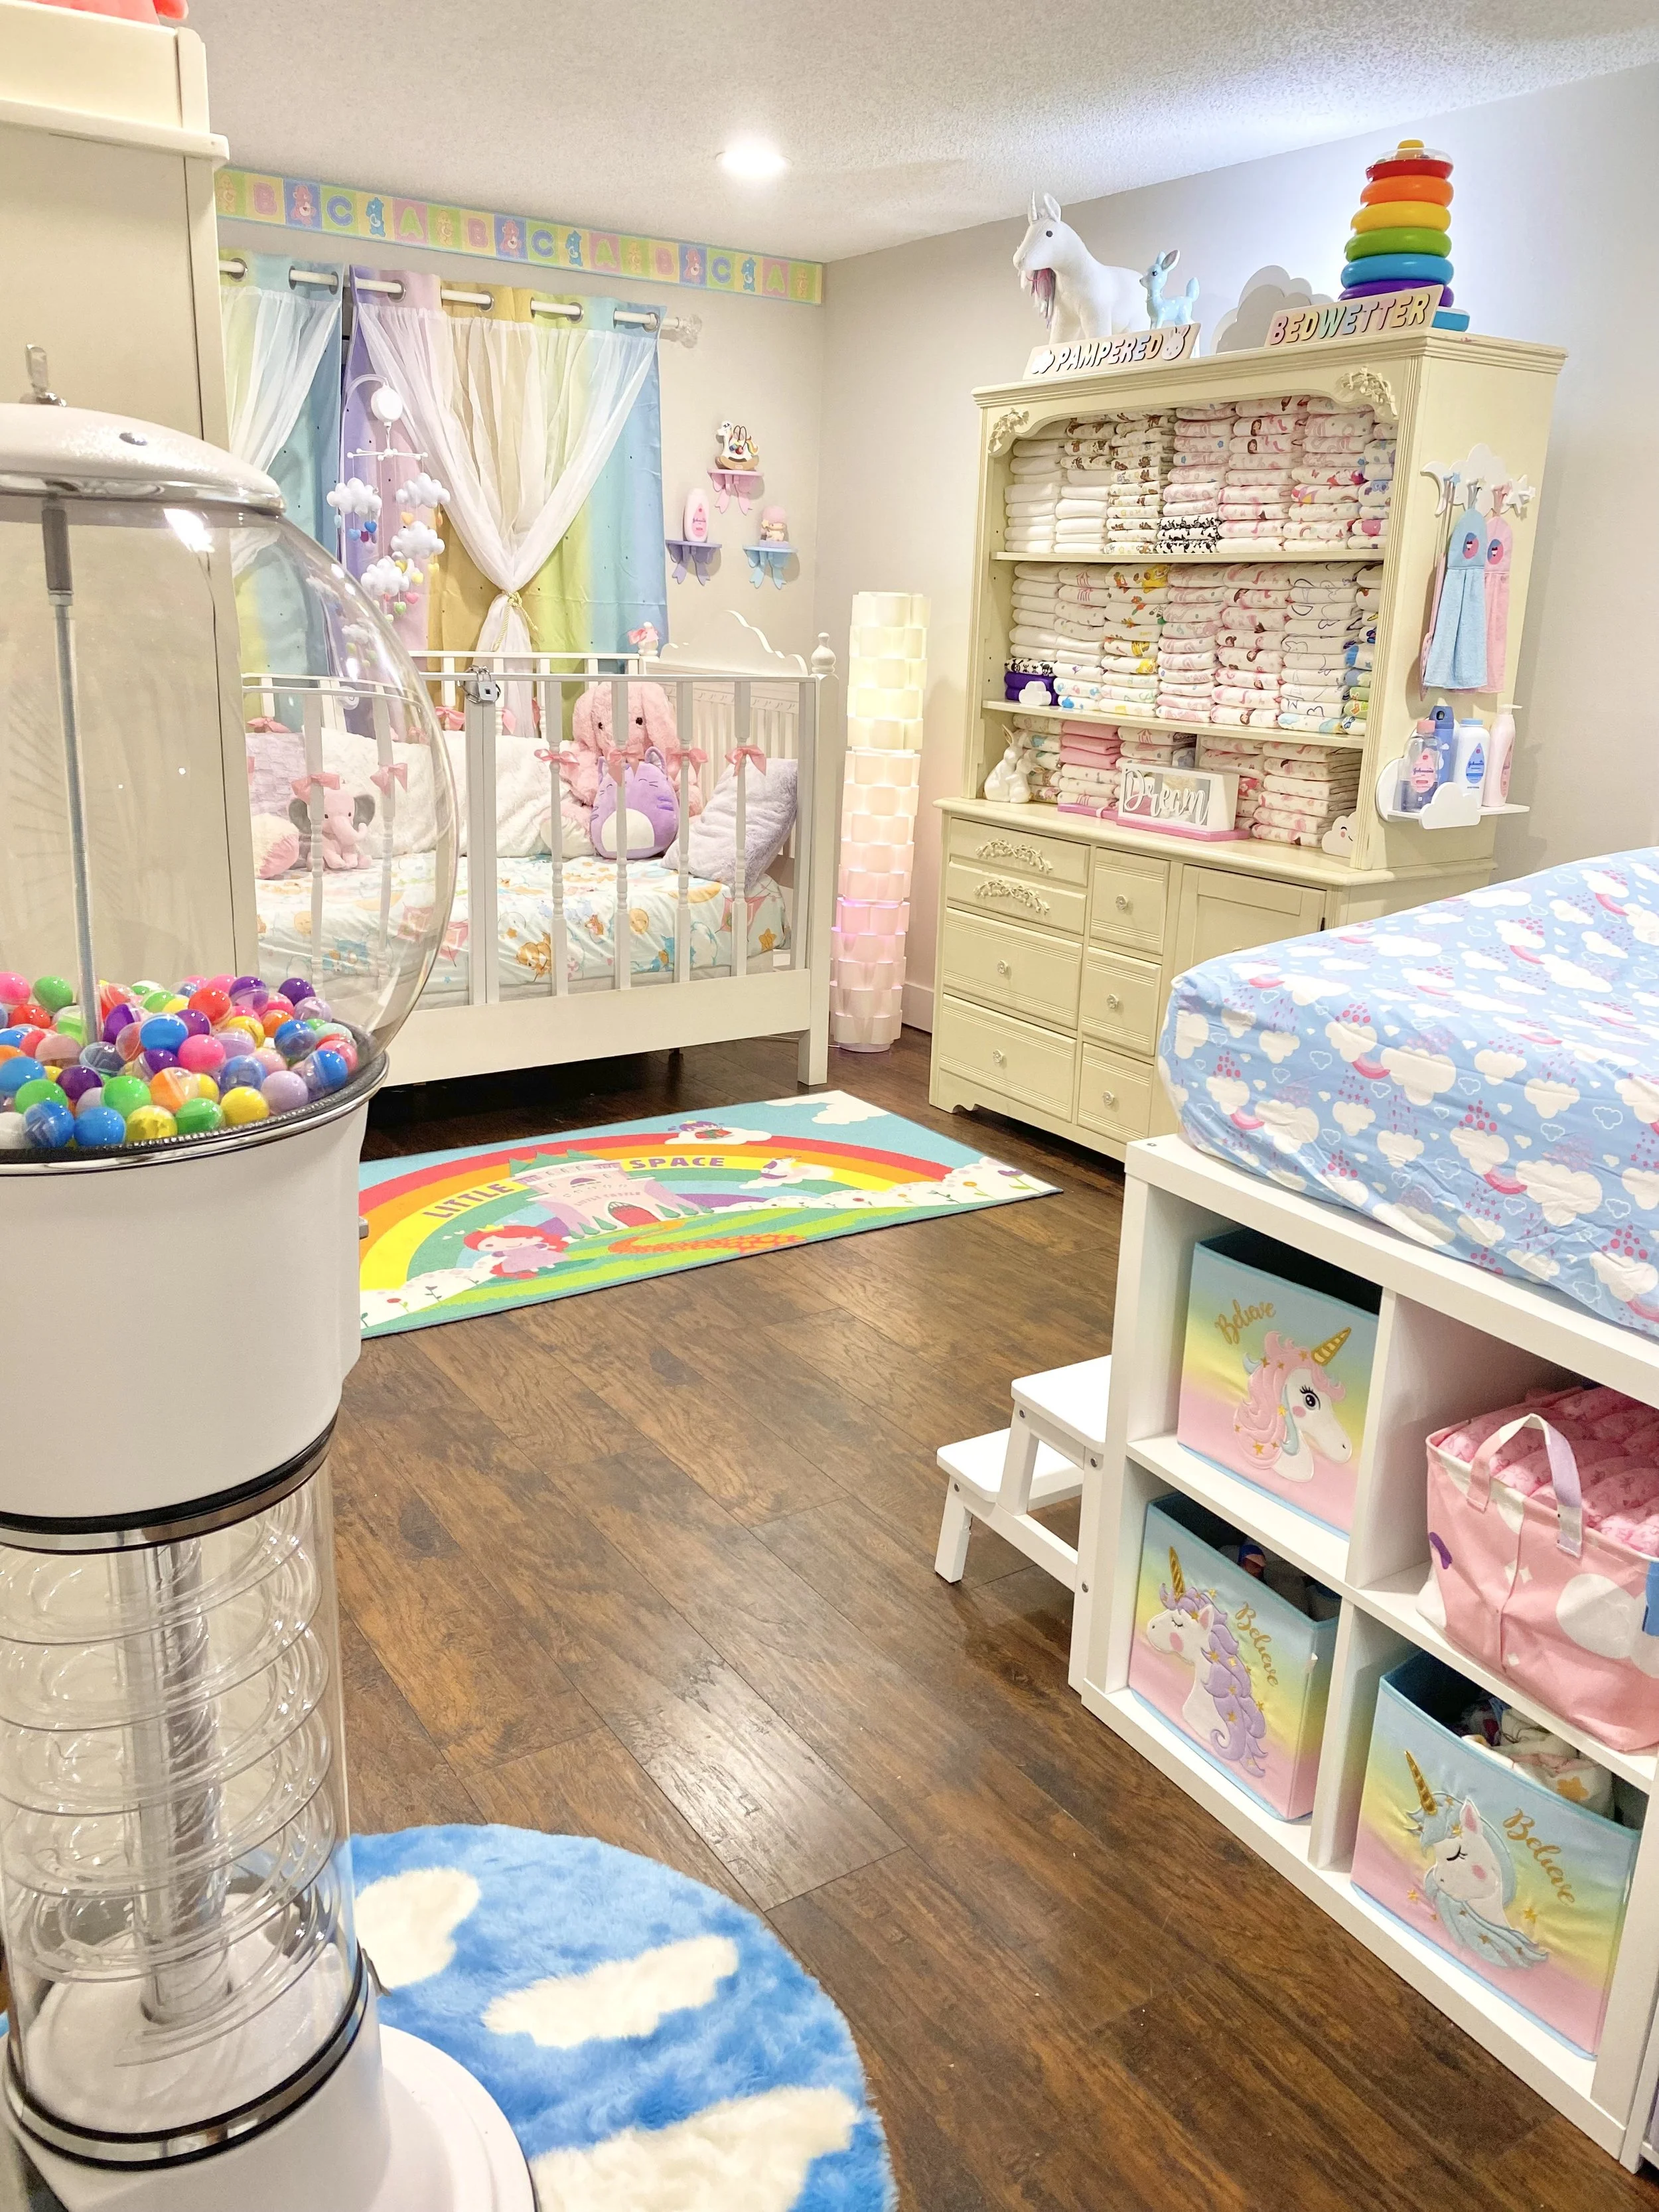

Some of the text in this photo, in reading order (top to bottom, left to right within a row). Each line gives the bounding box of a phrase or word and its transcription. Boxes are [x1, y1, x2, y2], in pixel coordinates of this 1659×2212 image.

[326, 194, 353, 226] C
[400, 206, 424, 239] A
[532, 229, 554, 258] C
[595, 239, 616, 268] A
[711, 256, 731, 283] C
[766, 264, 786, 293] A
[1270, 293, 1430, 345] BEDWETTER
[1056, 334, 1163, 372] PAMPERED
[1124, 770, 1210, 826] Dream
[423, 1157, 725, 1218] LITTLE SPACE
[1214, 1299, 1277, 1345] Believe
[1235, 1601, 1279, 1687] Believe
[1502, 1807, 1575, 1907] Believe
